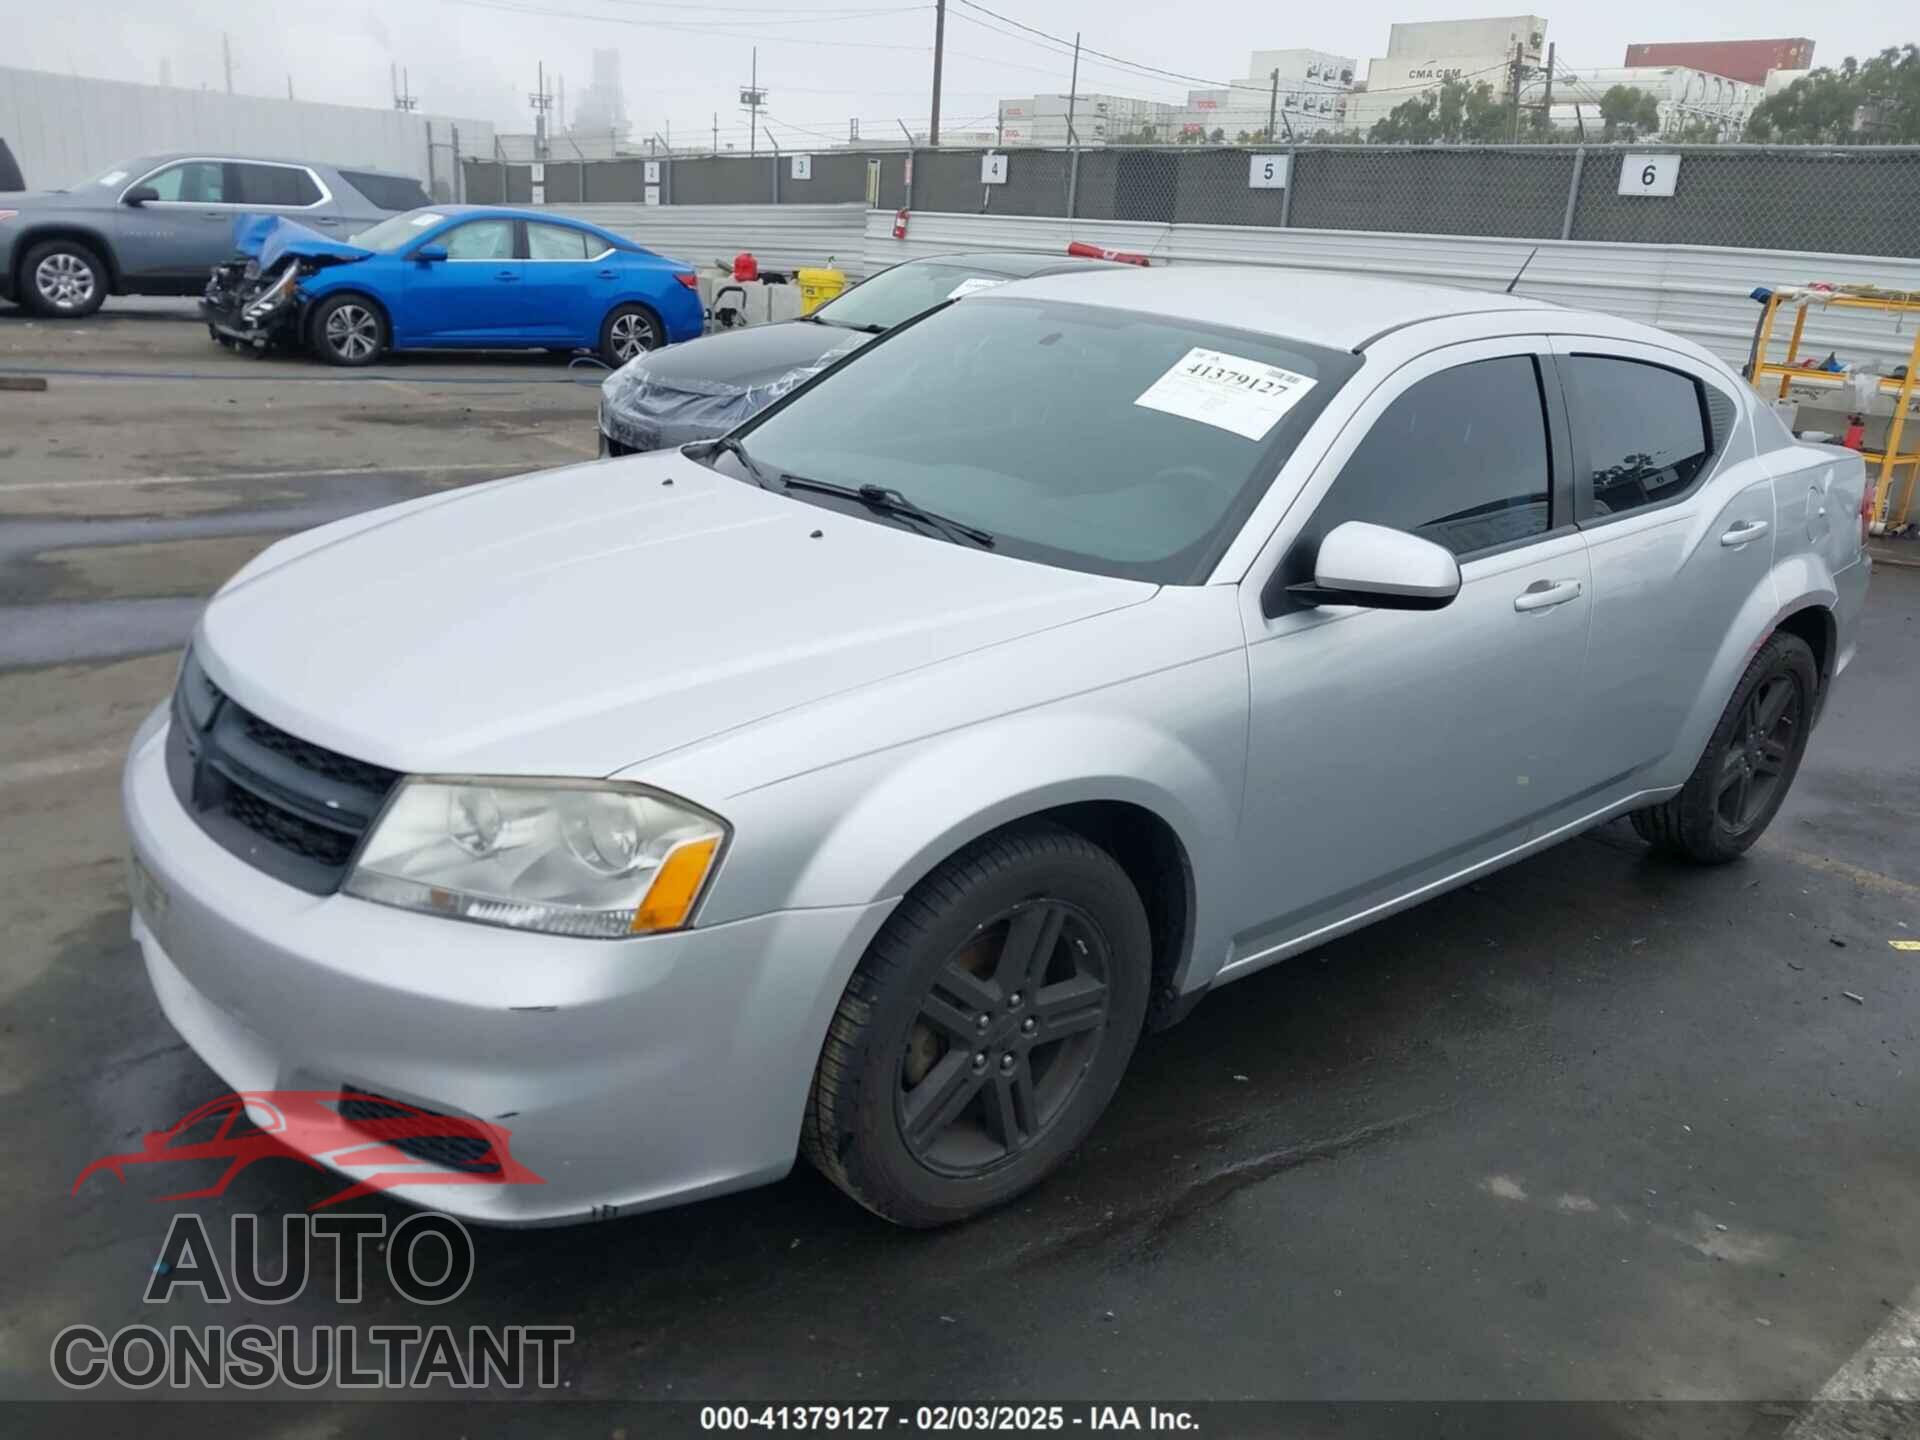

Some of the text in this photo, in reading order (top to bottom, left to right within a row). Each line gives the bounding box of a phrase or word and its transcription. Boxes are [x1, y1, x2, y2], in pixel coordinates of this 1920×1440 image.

[1408, 69, 1433, 79] CMA
[991, 162, 999, 176] 4
[1264, 163, 1274, 180] 5
[1642, 165, 1657, 185] 6
[1187, 363, 1289, 398] 41379127
